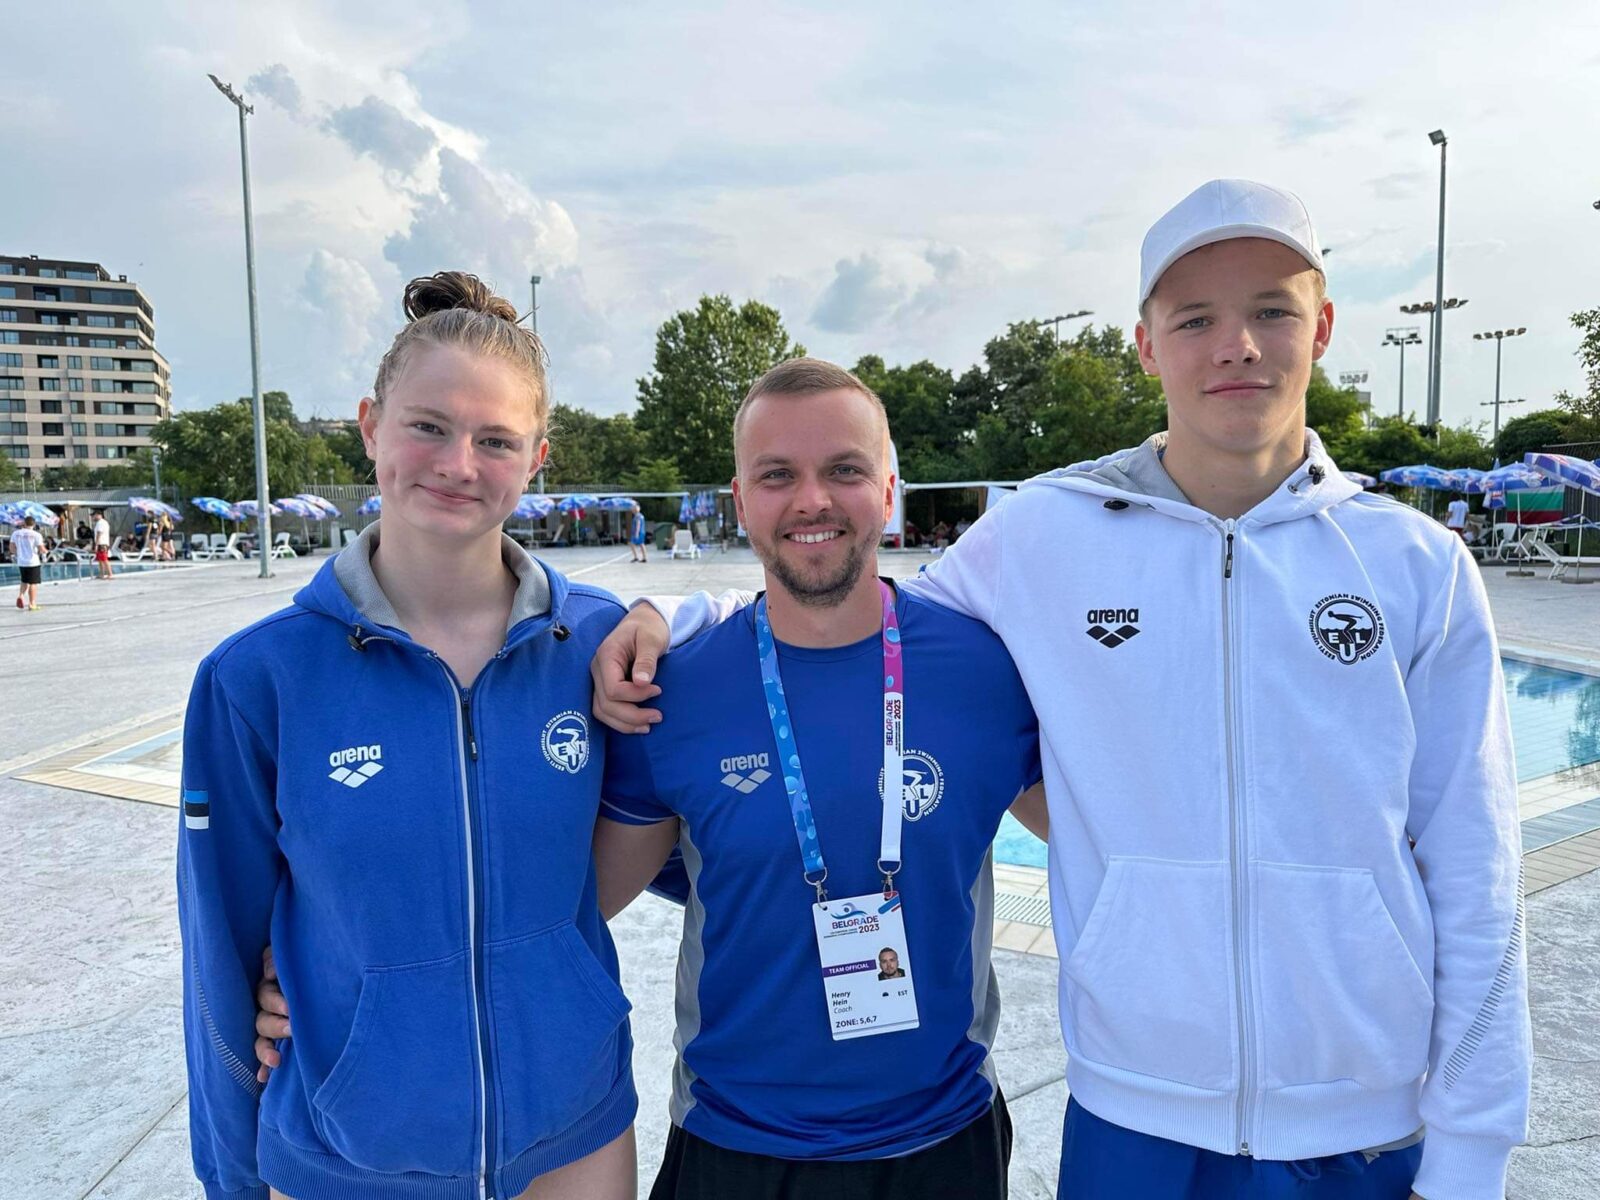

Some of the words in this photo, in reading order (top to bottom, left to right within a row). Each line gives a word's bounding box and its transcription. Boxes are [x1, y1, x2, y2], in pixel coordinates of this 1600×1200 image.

[1315, 593, 1349, 609] ESTONIAN
[1351, 594, 1382, 622] SWIMMING
[1087, 608, 1139, 624] arena
[1360, 622, 1385, 661] FEDERATION
[1318, 646, 1336, 661] EESTI
[329, 744, 382, 767] arena
[720, 752, 769, 773] arena
[917, 749, 944, 778] SWIMMING
[832, 915, 879, 930] BELGRADE
[858, 923, 880, 934] 2023
[829, 966, 845, 974] TEAM
[846, 963, 869, 972] OFFICIAL
[832, 990, 850, 998] Henry
[834, 1005, 852, 1013] Coach
[836, 1019, 858, 1027] ZONE:
[860, 1016, 877, 1025] 5,6,7
